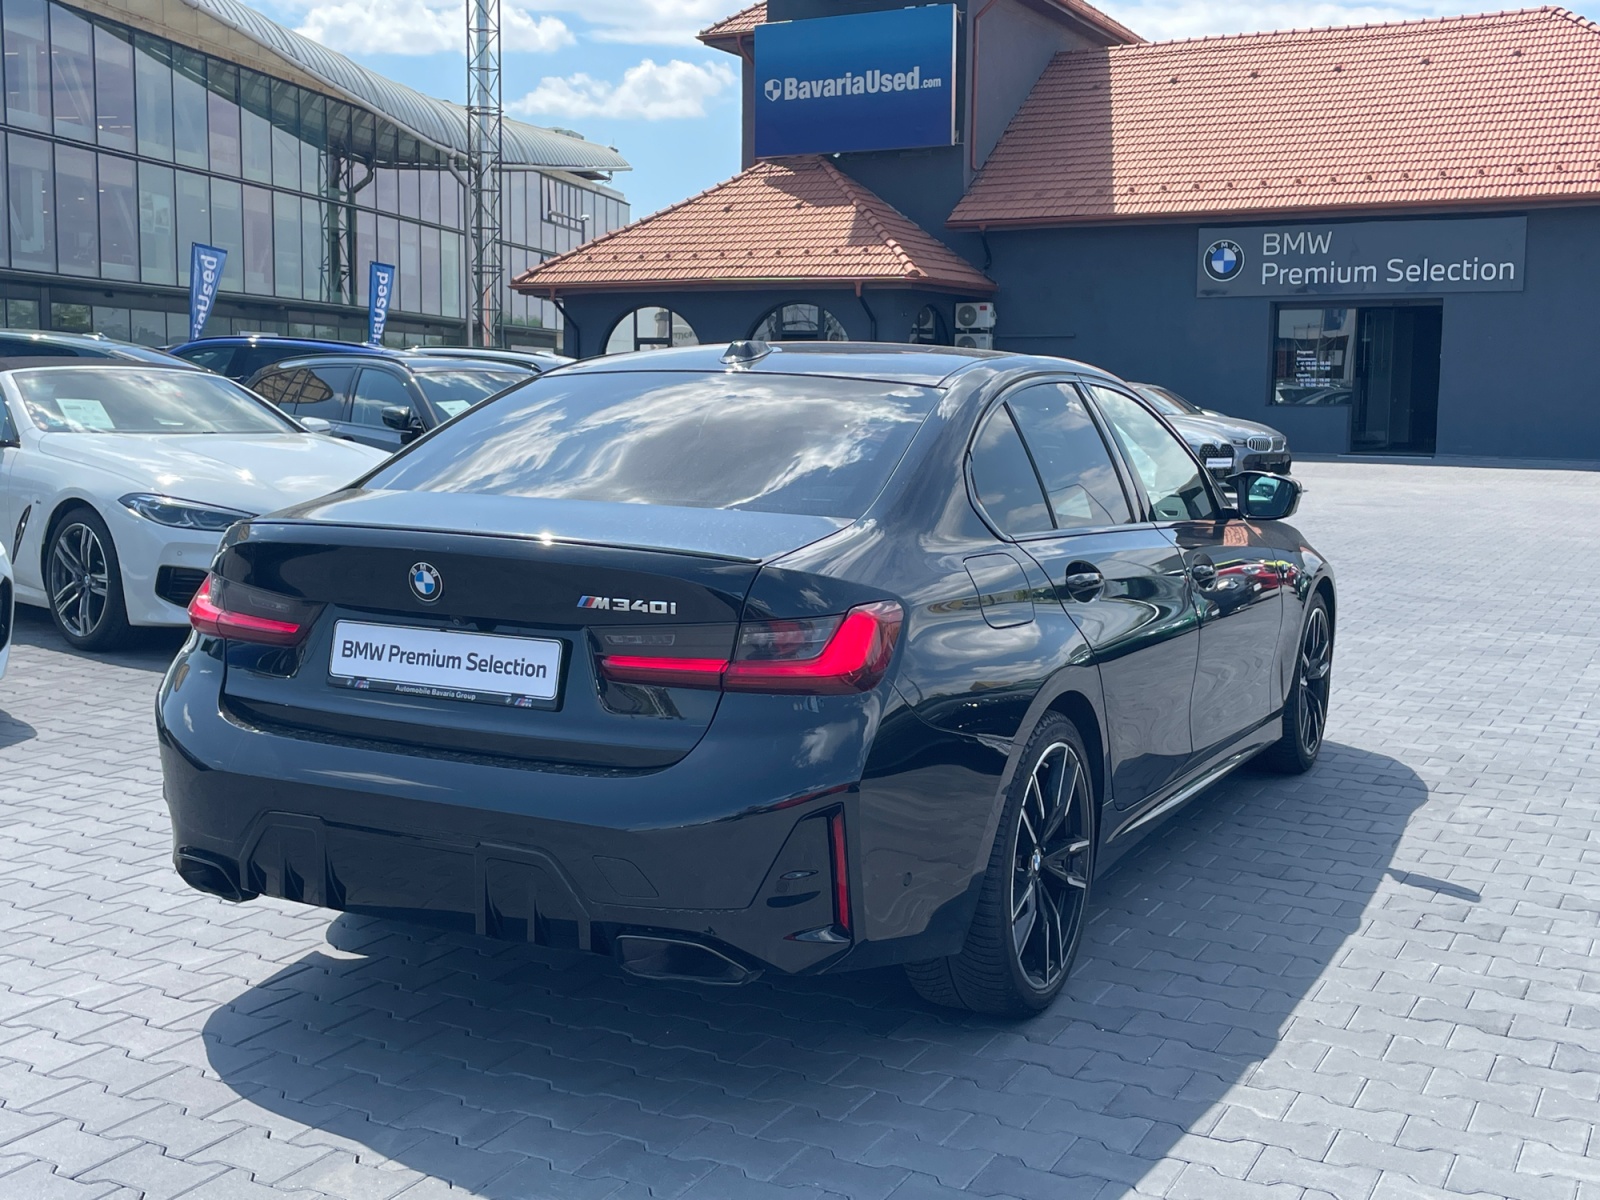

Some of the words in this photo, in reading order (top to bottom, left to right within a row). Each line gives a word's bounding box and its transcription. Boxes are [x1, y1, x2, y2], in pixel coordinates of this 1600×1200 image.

[1262, 231, 1333, 256] BMW
[1261, 260, 1377, 285] Premium
[1386, 257, 1515, 283] Selection
[341, 640, 386, 662] BMW
[388, 645, 462, 670] Premium
[466, 652, 548, 679] Selection
[395, 684, 431, 696] Automobile
[431, 688, 455, 698] Bavaria
[456, 691, 476, 701] Group
